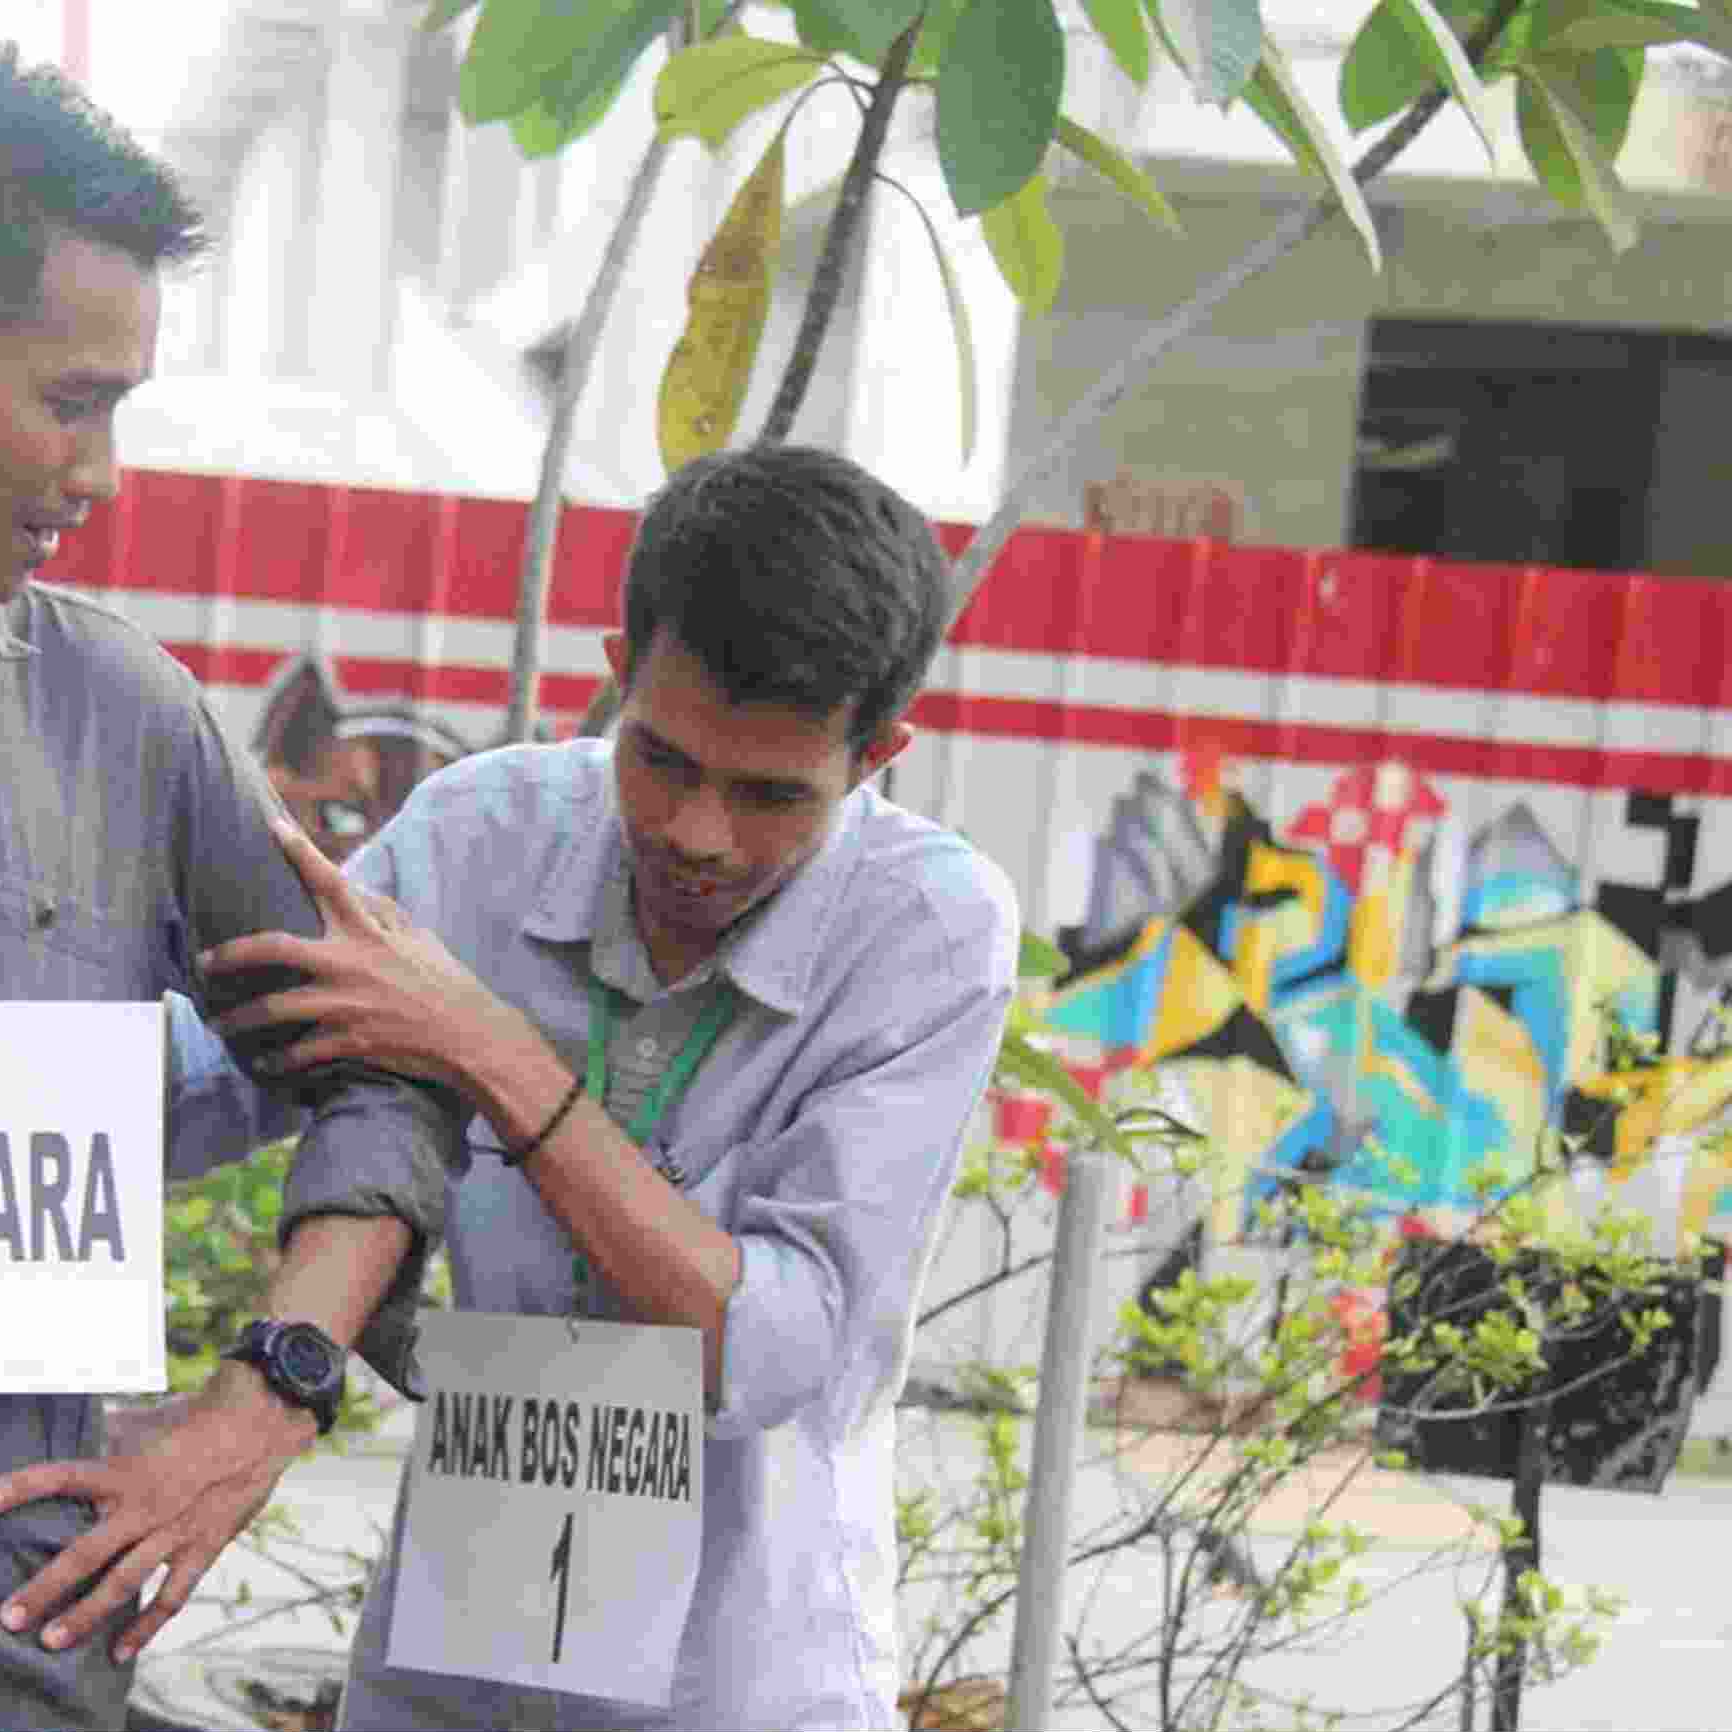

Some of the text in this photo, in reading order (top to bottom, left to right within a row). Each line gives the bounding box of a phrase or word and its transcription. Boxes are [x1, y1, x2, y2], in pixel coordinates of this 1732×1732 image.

[427, 1391, 692, 1502] ANAK BOS NEGARA
[549, 1512, 575, 1664] 1
